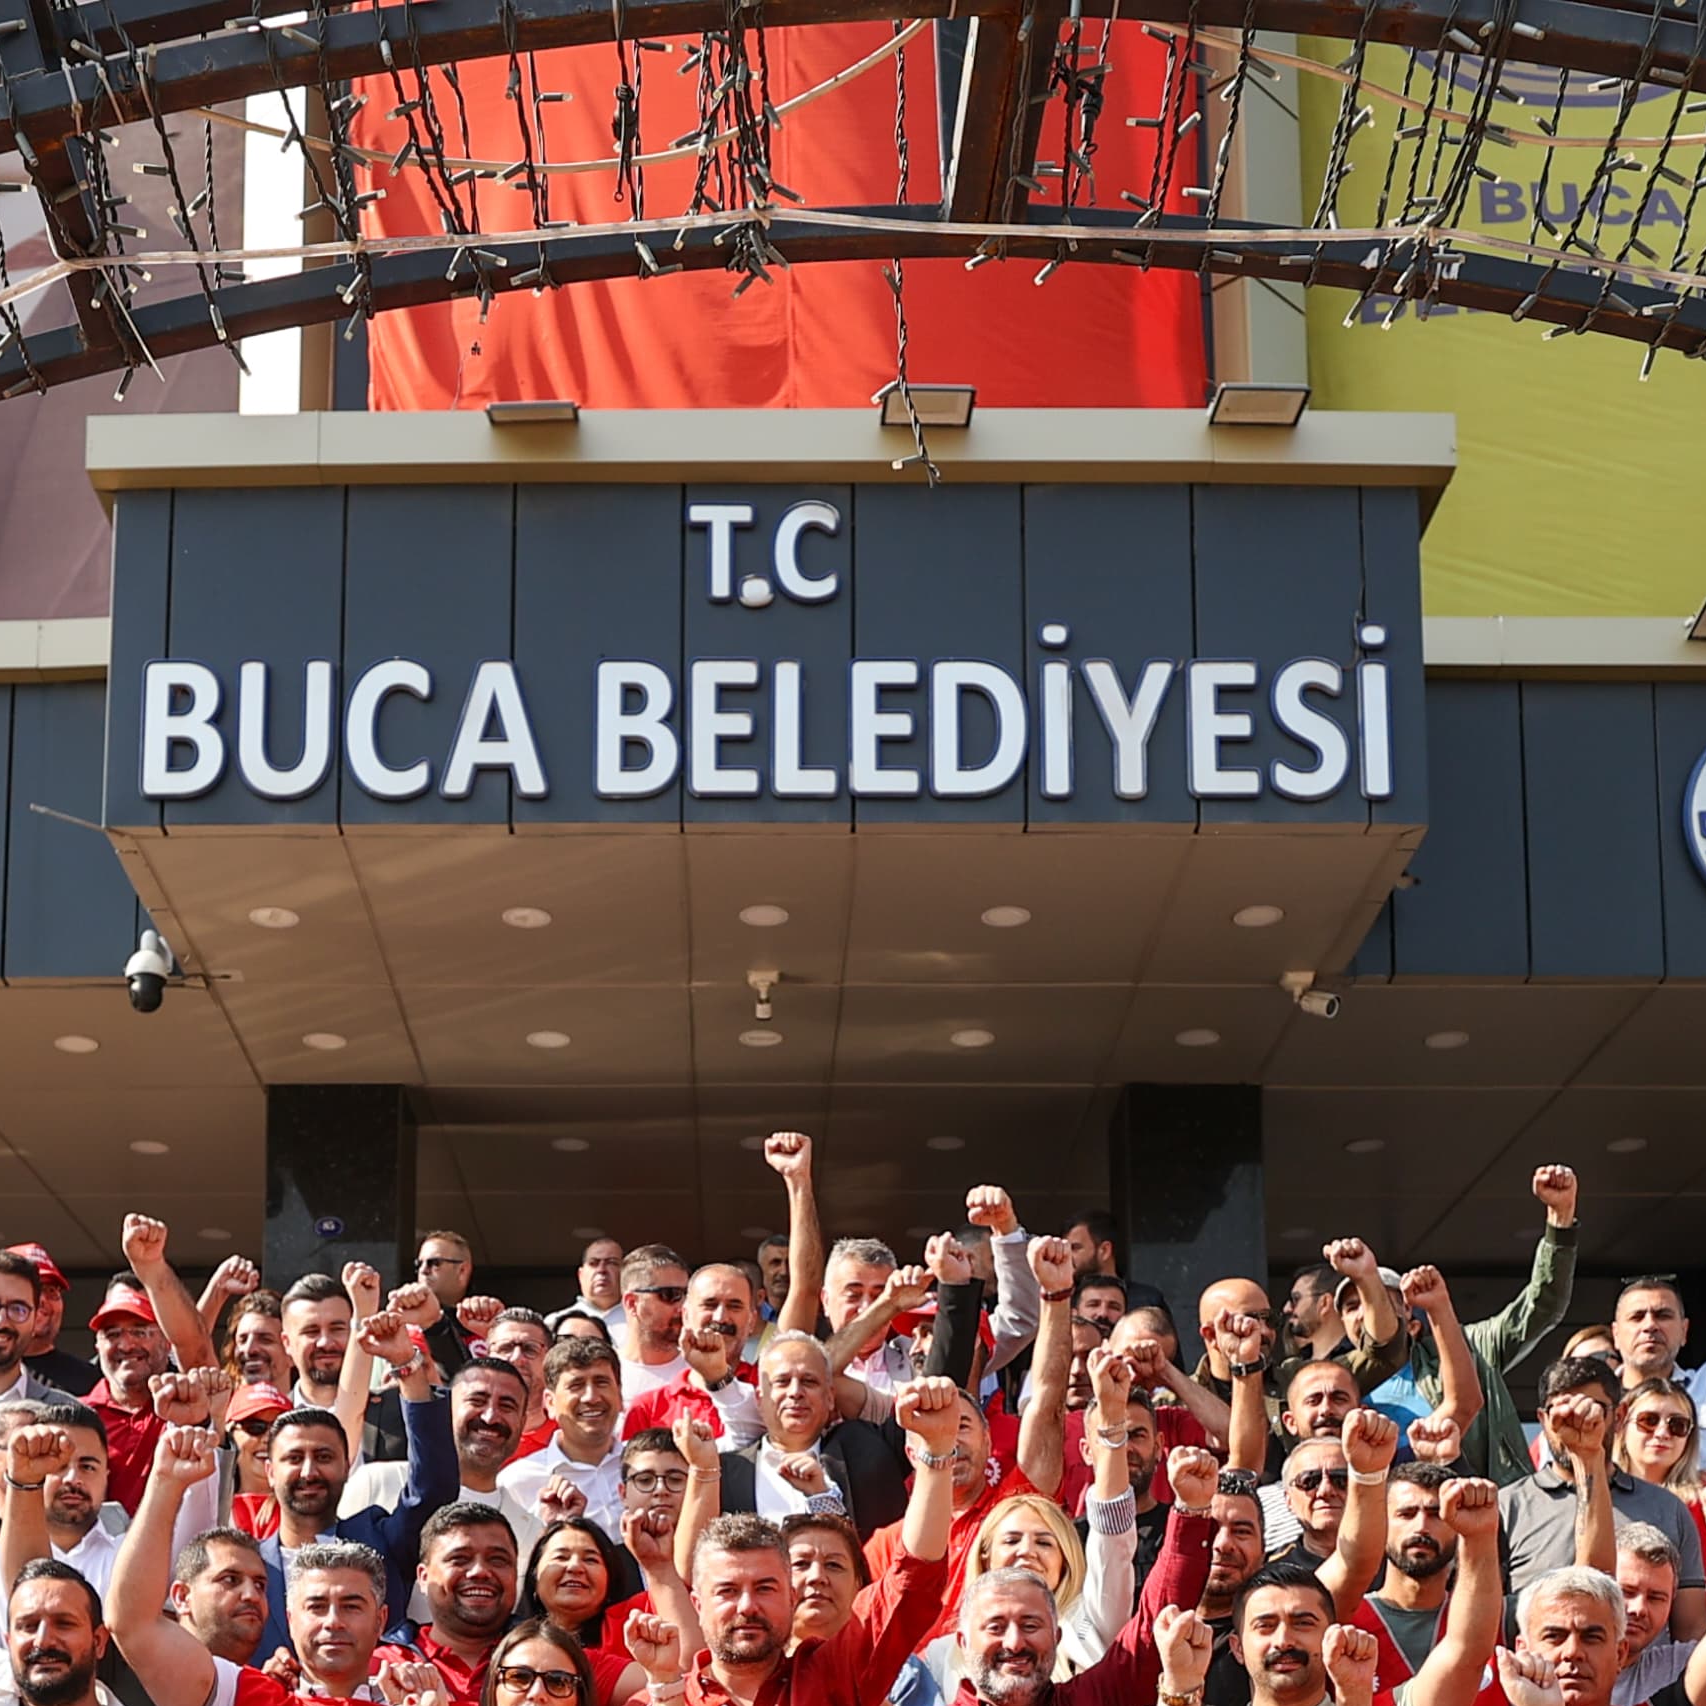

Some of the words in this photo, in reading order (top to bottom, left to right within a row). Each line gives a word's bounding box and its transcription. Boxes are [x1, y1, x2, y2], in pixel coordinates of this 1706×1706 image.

[1479, 180, 1684, 228] BUCA
[687, 499, 840, 608] T.C
[141, 658, 550, 799] BUCA
[594, 620, 1394, 799] BELEDİYESİ
